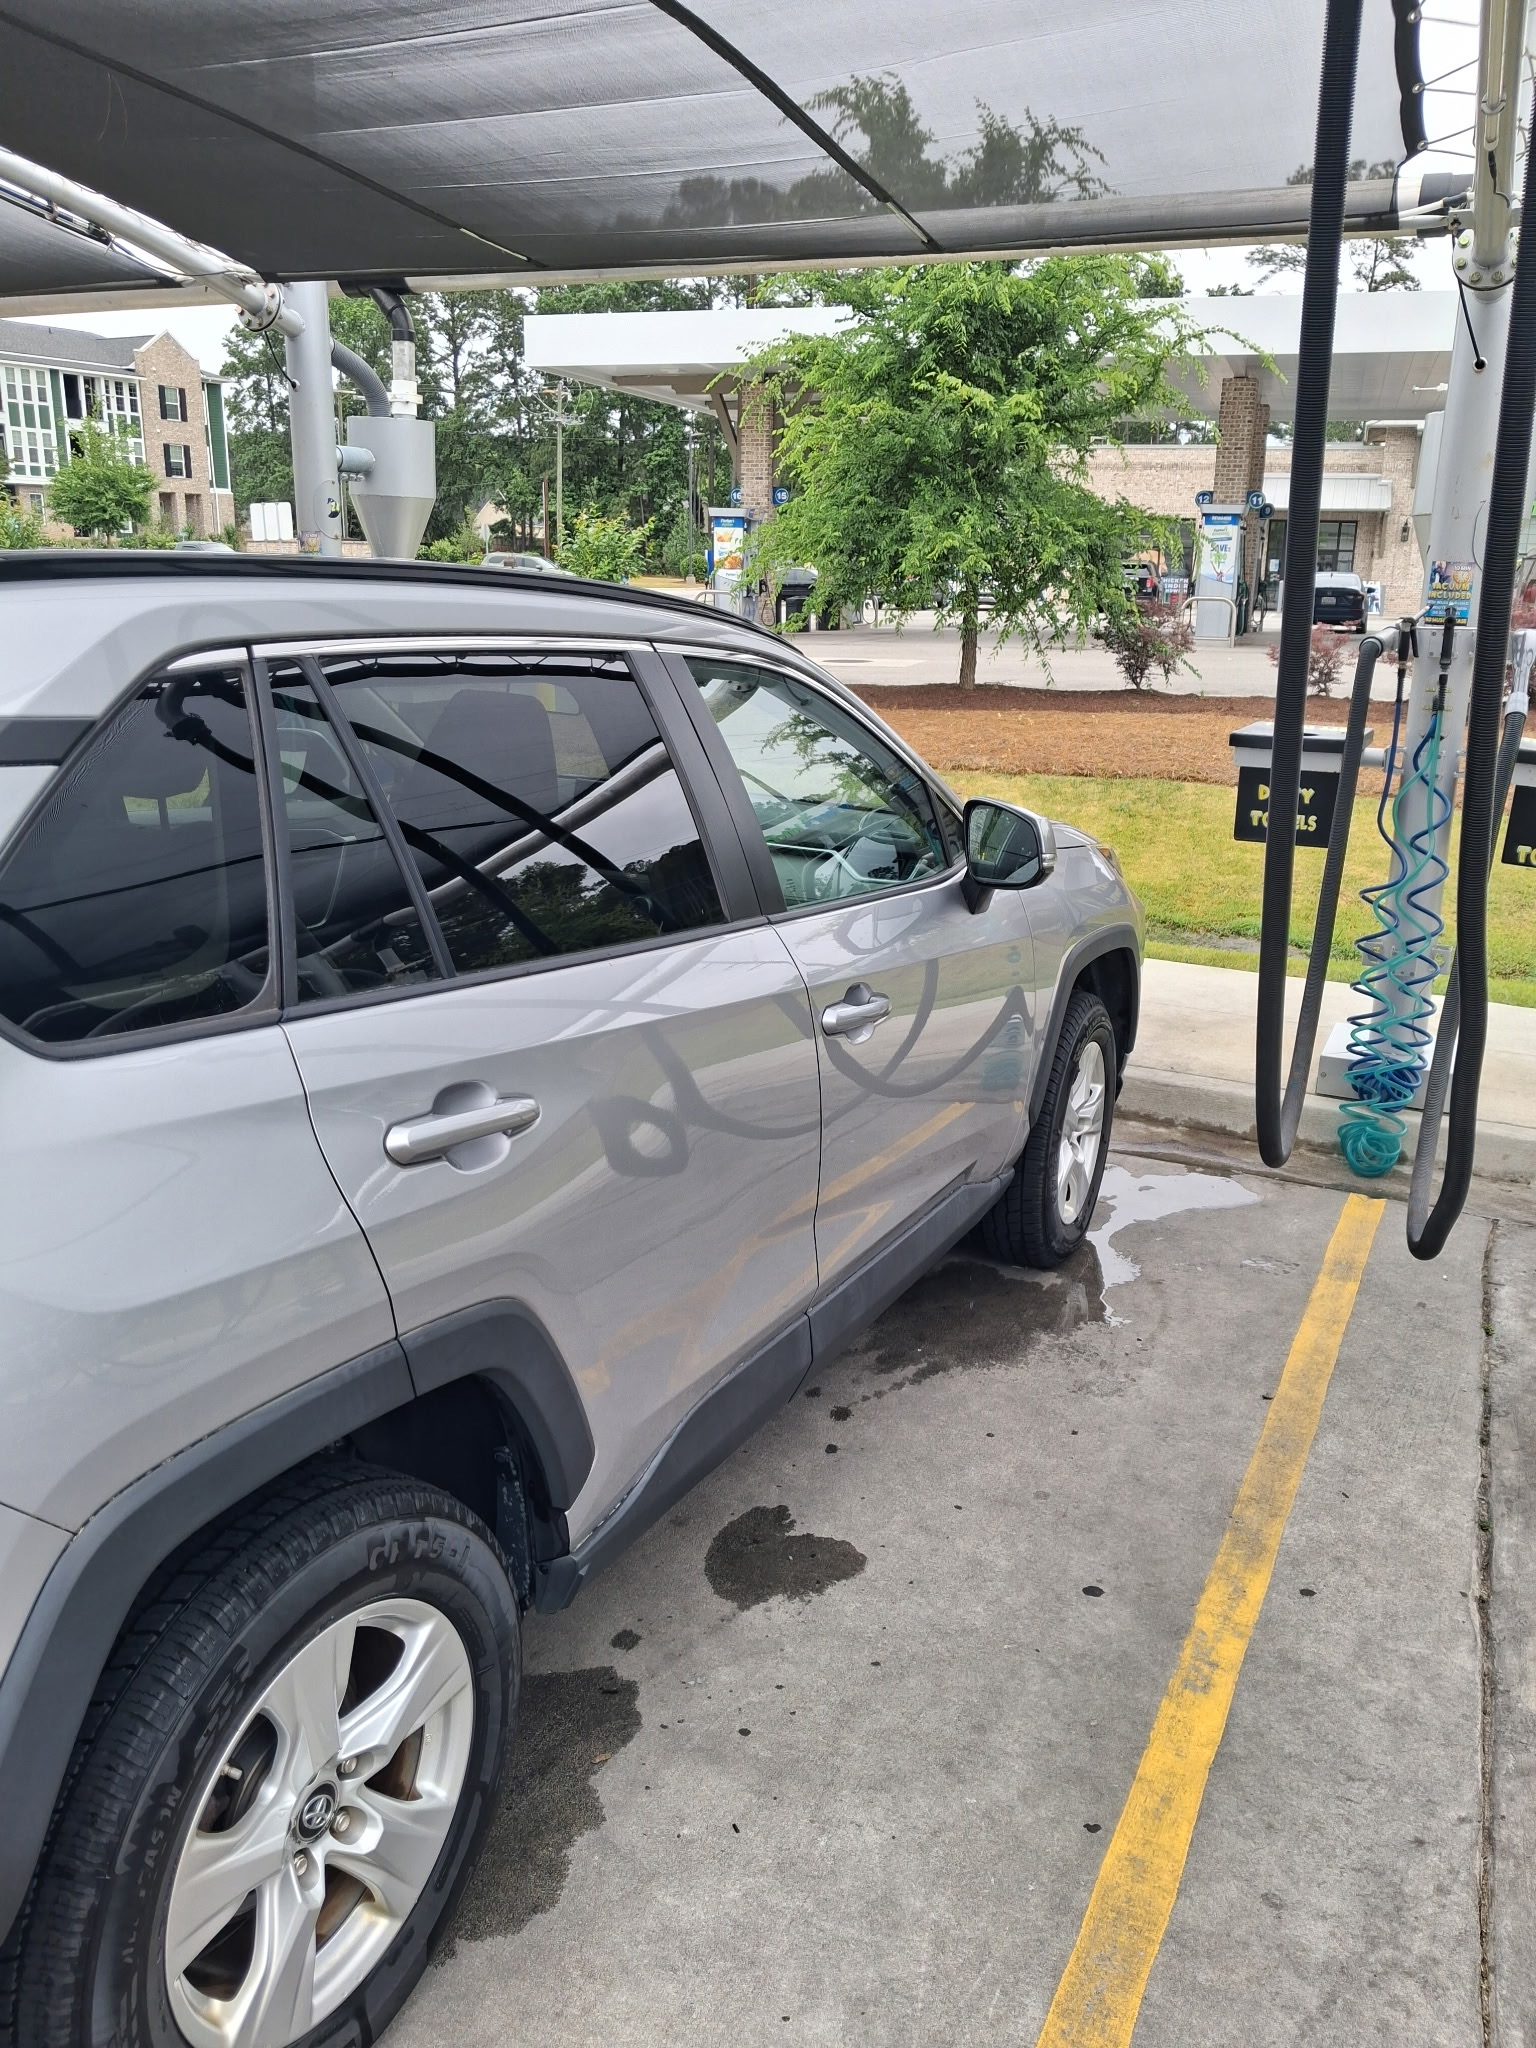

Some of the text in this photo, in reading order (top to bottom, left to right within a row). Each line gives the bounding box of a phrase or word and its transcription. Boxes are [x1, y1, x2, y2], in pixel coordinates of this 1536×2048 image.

[1198, 495, 1210, 504] 12
[1252, 496, 1263, 505] 11
[1428, 591, 1472, 599] INCLUDED
